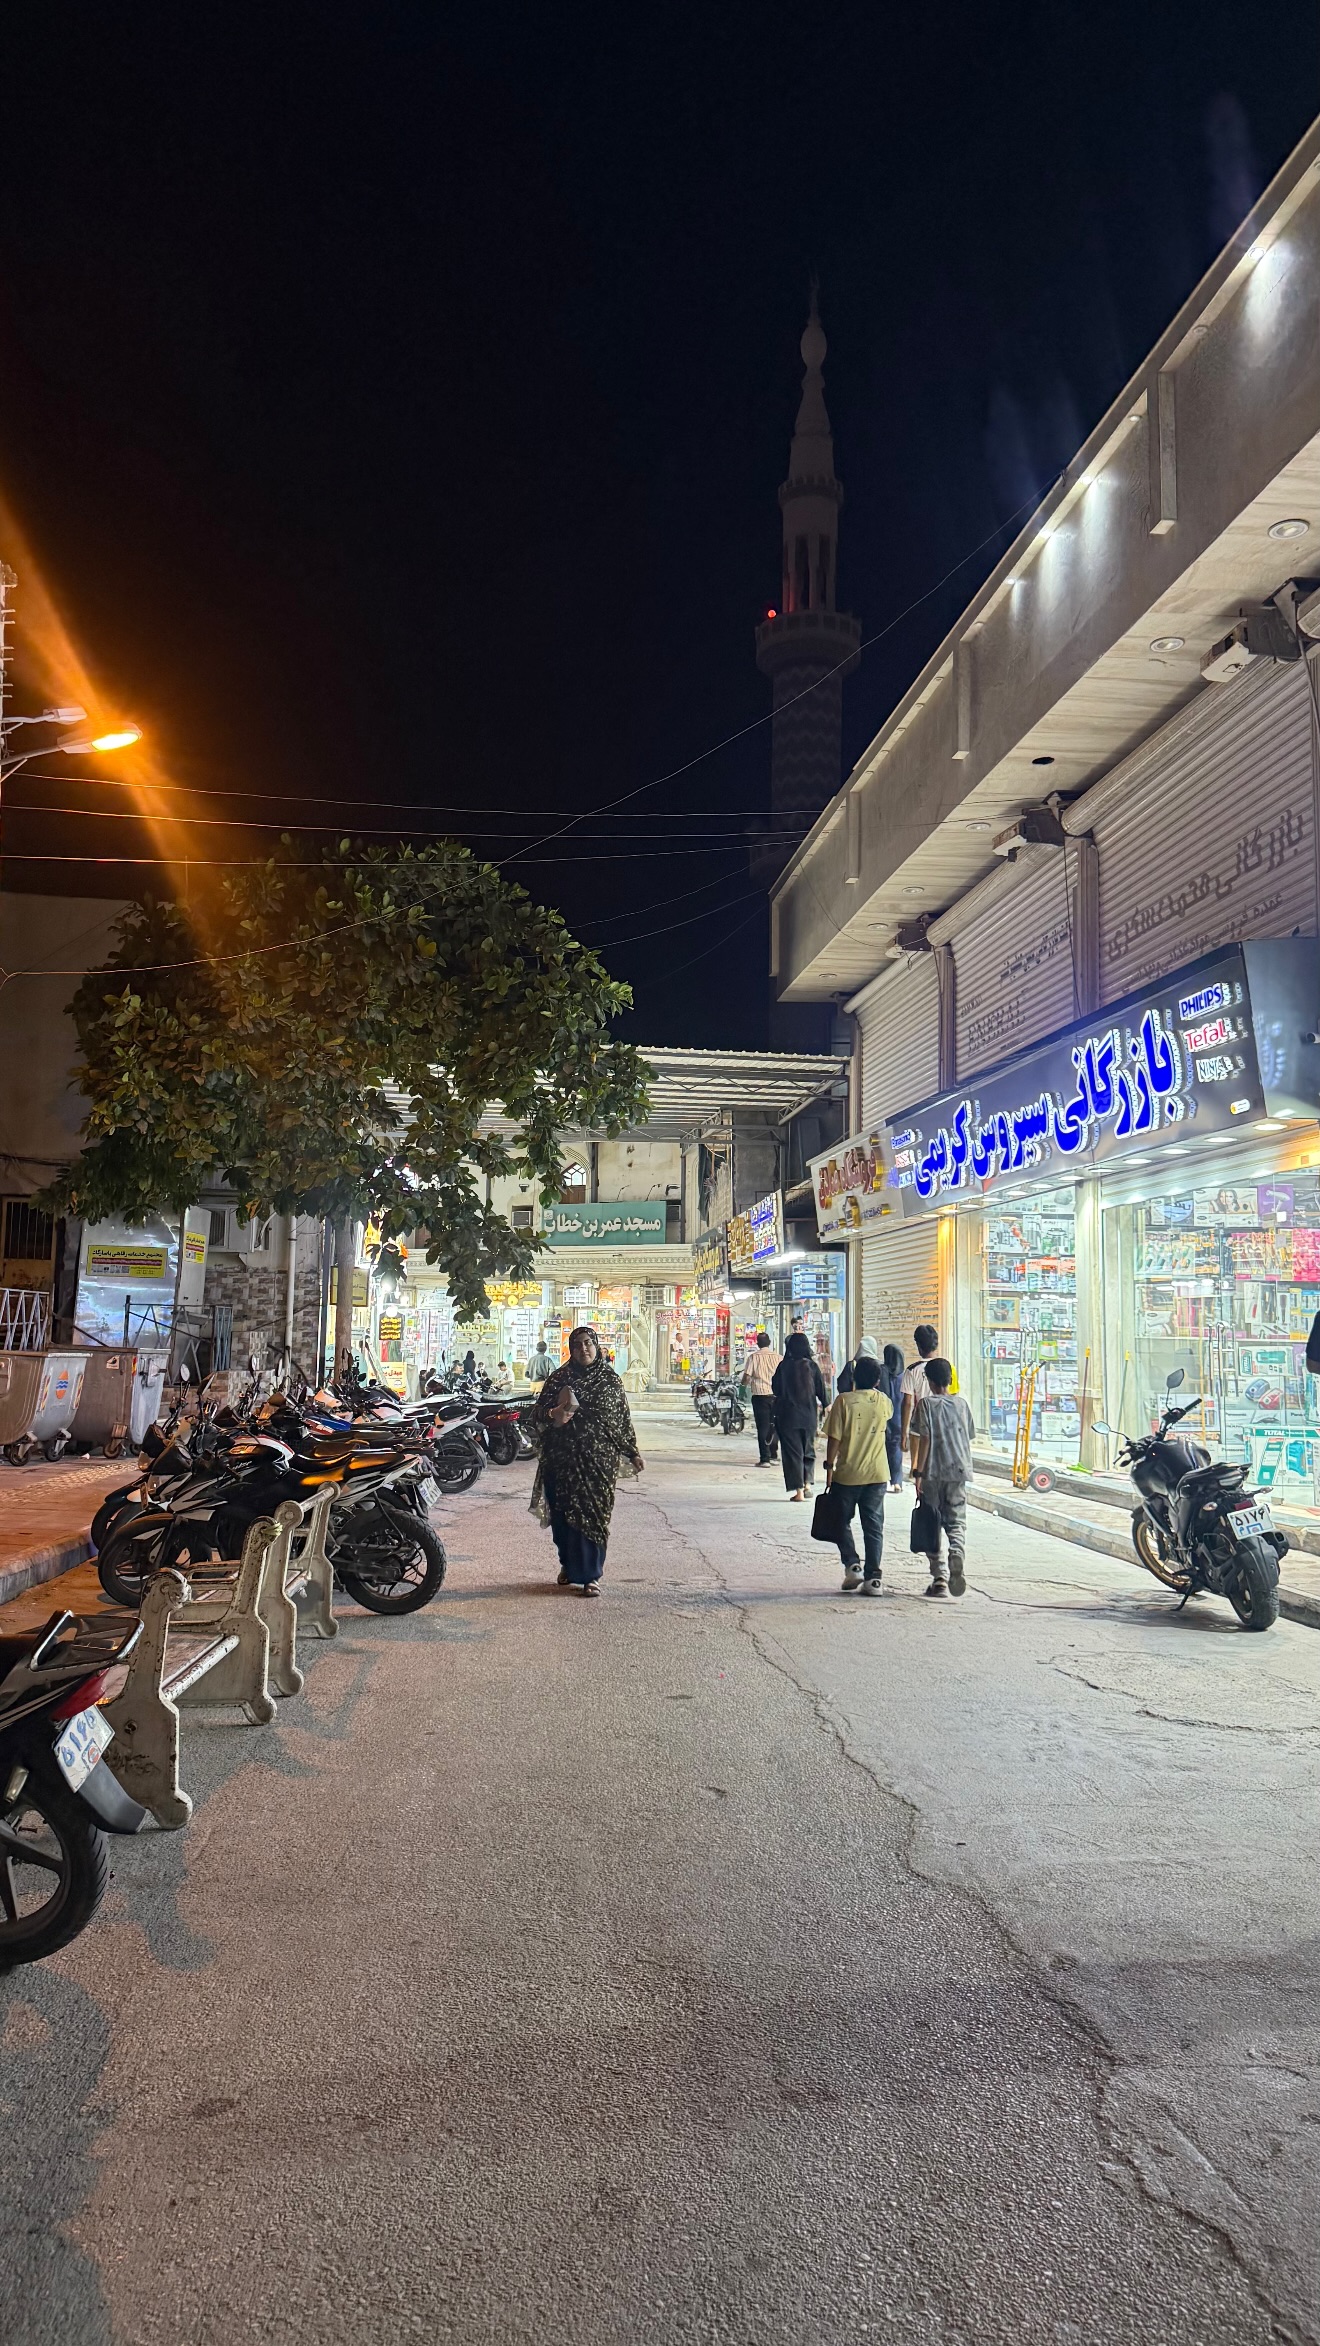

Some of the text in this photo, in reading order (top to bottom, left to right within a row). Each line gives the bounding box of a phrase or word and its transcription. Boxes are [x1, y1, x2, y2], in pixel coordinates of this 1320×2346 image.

[1215, 809, 1303, 900] بازرگانی
[1180, 984, 1223, 1019] PHILIPS
[1185, 1019, 1228, 1052] Tefal
[1055, 1010, 1180, 1153] بازرگانی
[915, 1100, 971, 1198] کریمی
[972, 1093, 1051, 1179] سیروس
[544, 1213, 582, 1238] خطاب
[582, 1219, 598, 1238] بن
[598, 1217, 621, 1238] عمر
[623, 1217, 661, 1237] مسجد
